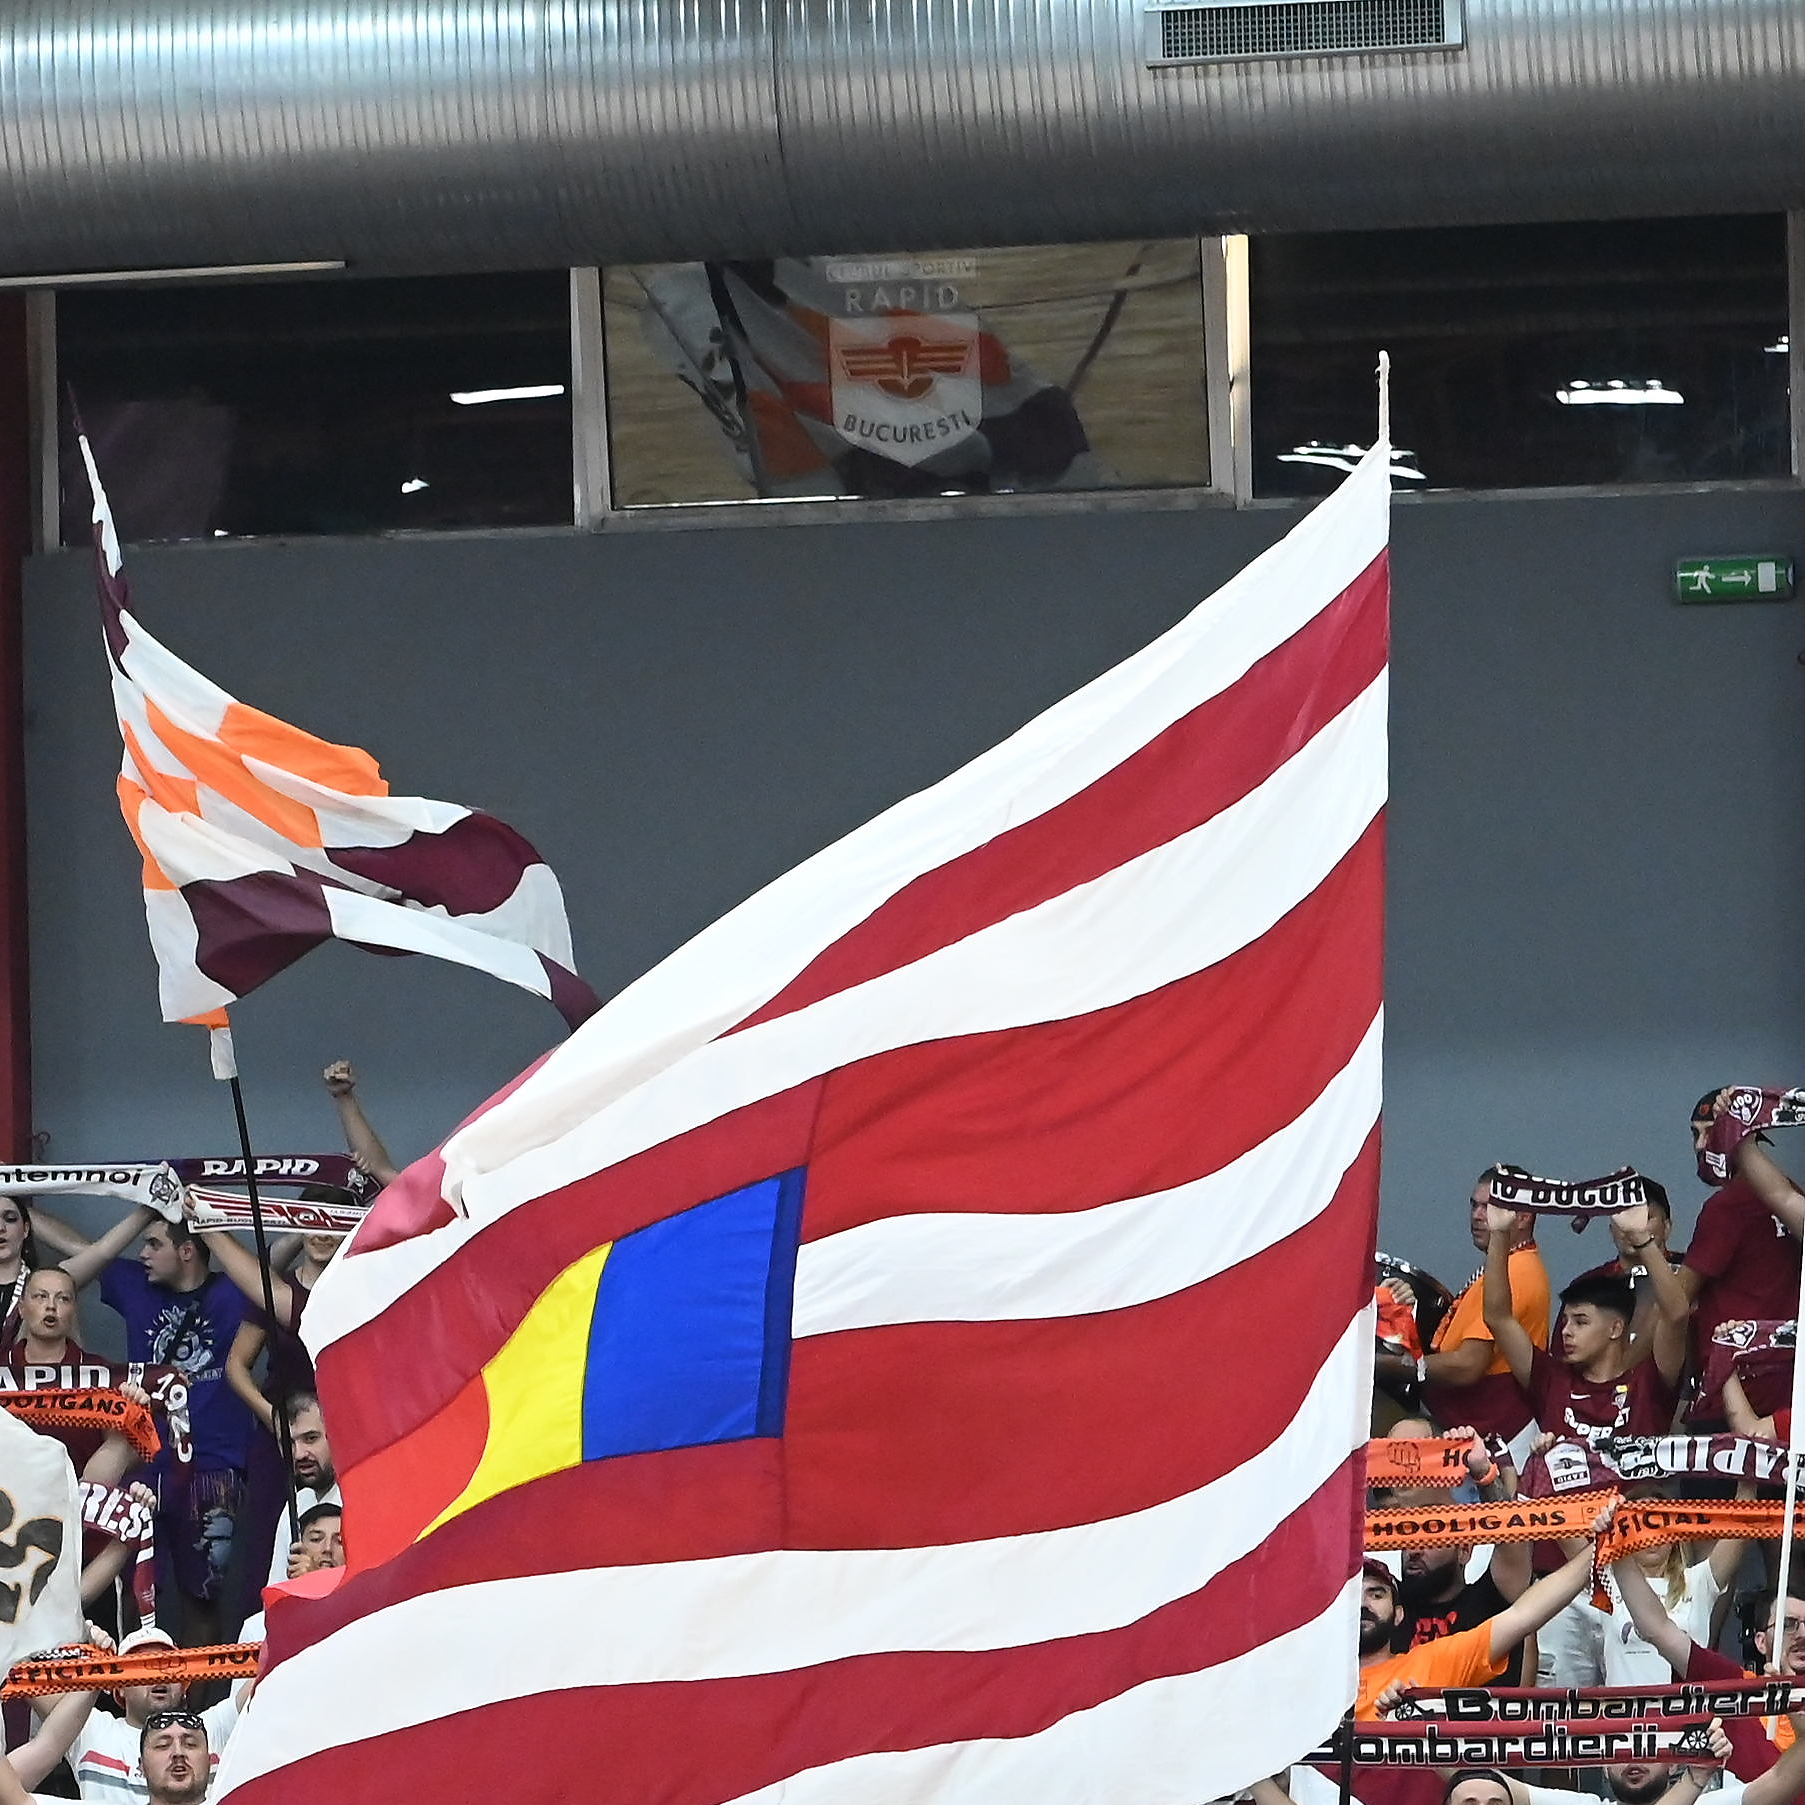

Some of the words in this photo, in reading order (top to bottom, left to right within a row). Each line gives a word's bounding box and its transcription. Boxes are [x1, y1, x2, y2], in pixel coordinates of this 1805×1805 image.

[845, 285, 960, 312] RAPID
[843, 409, 972, 444] BUCURESTI
[201, 1158, 320, 1177] RAPID
[1372, 1508, 1567, 1537] HOOLIGANS
[1608, 1512, 1712, 1540] FFICIAL
[9, 1661, 125, 1685] FFICIAL
[1444, 1680, 1792, 1722] Bombardierii
